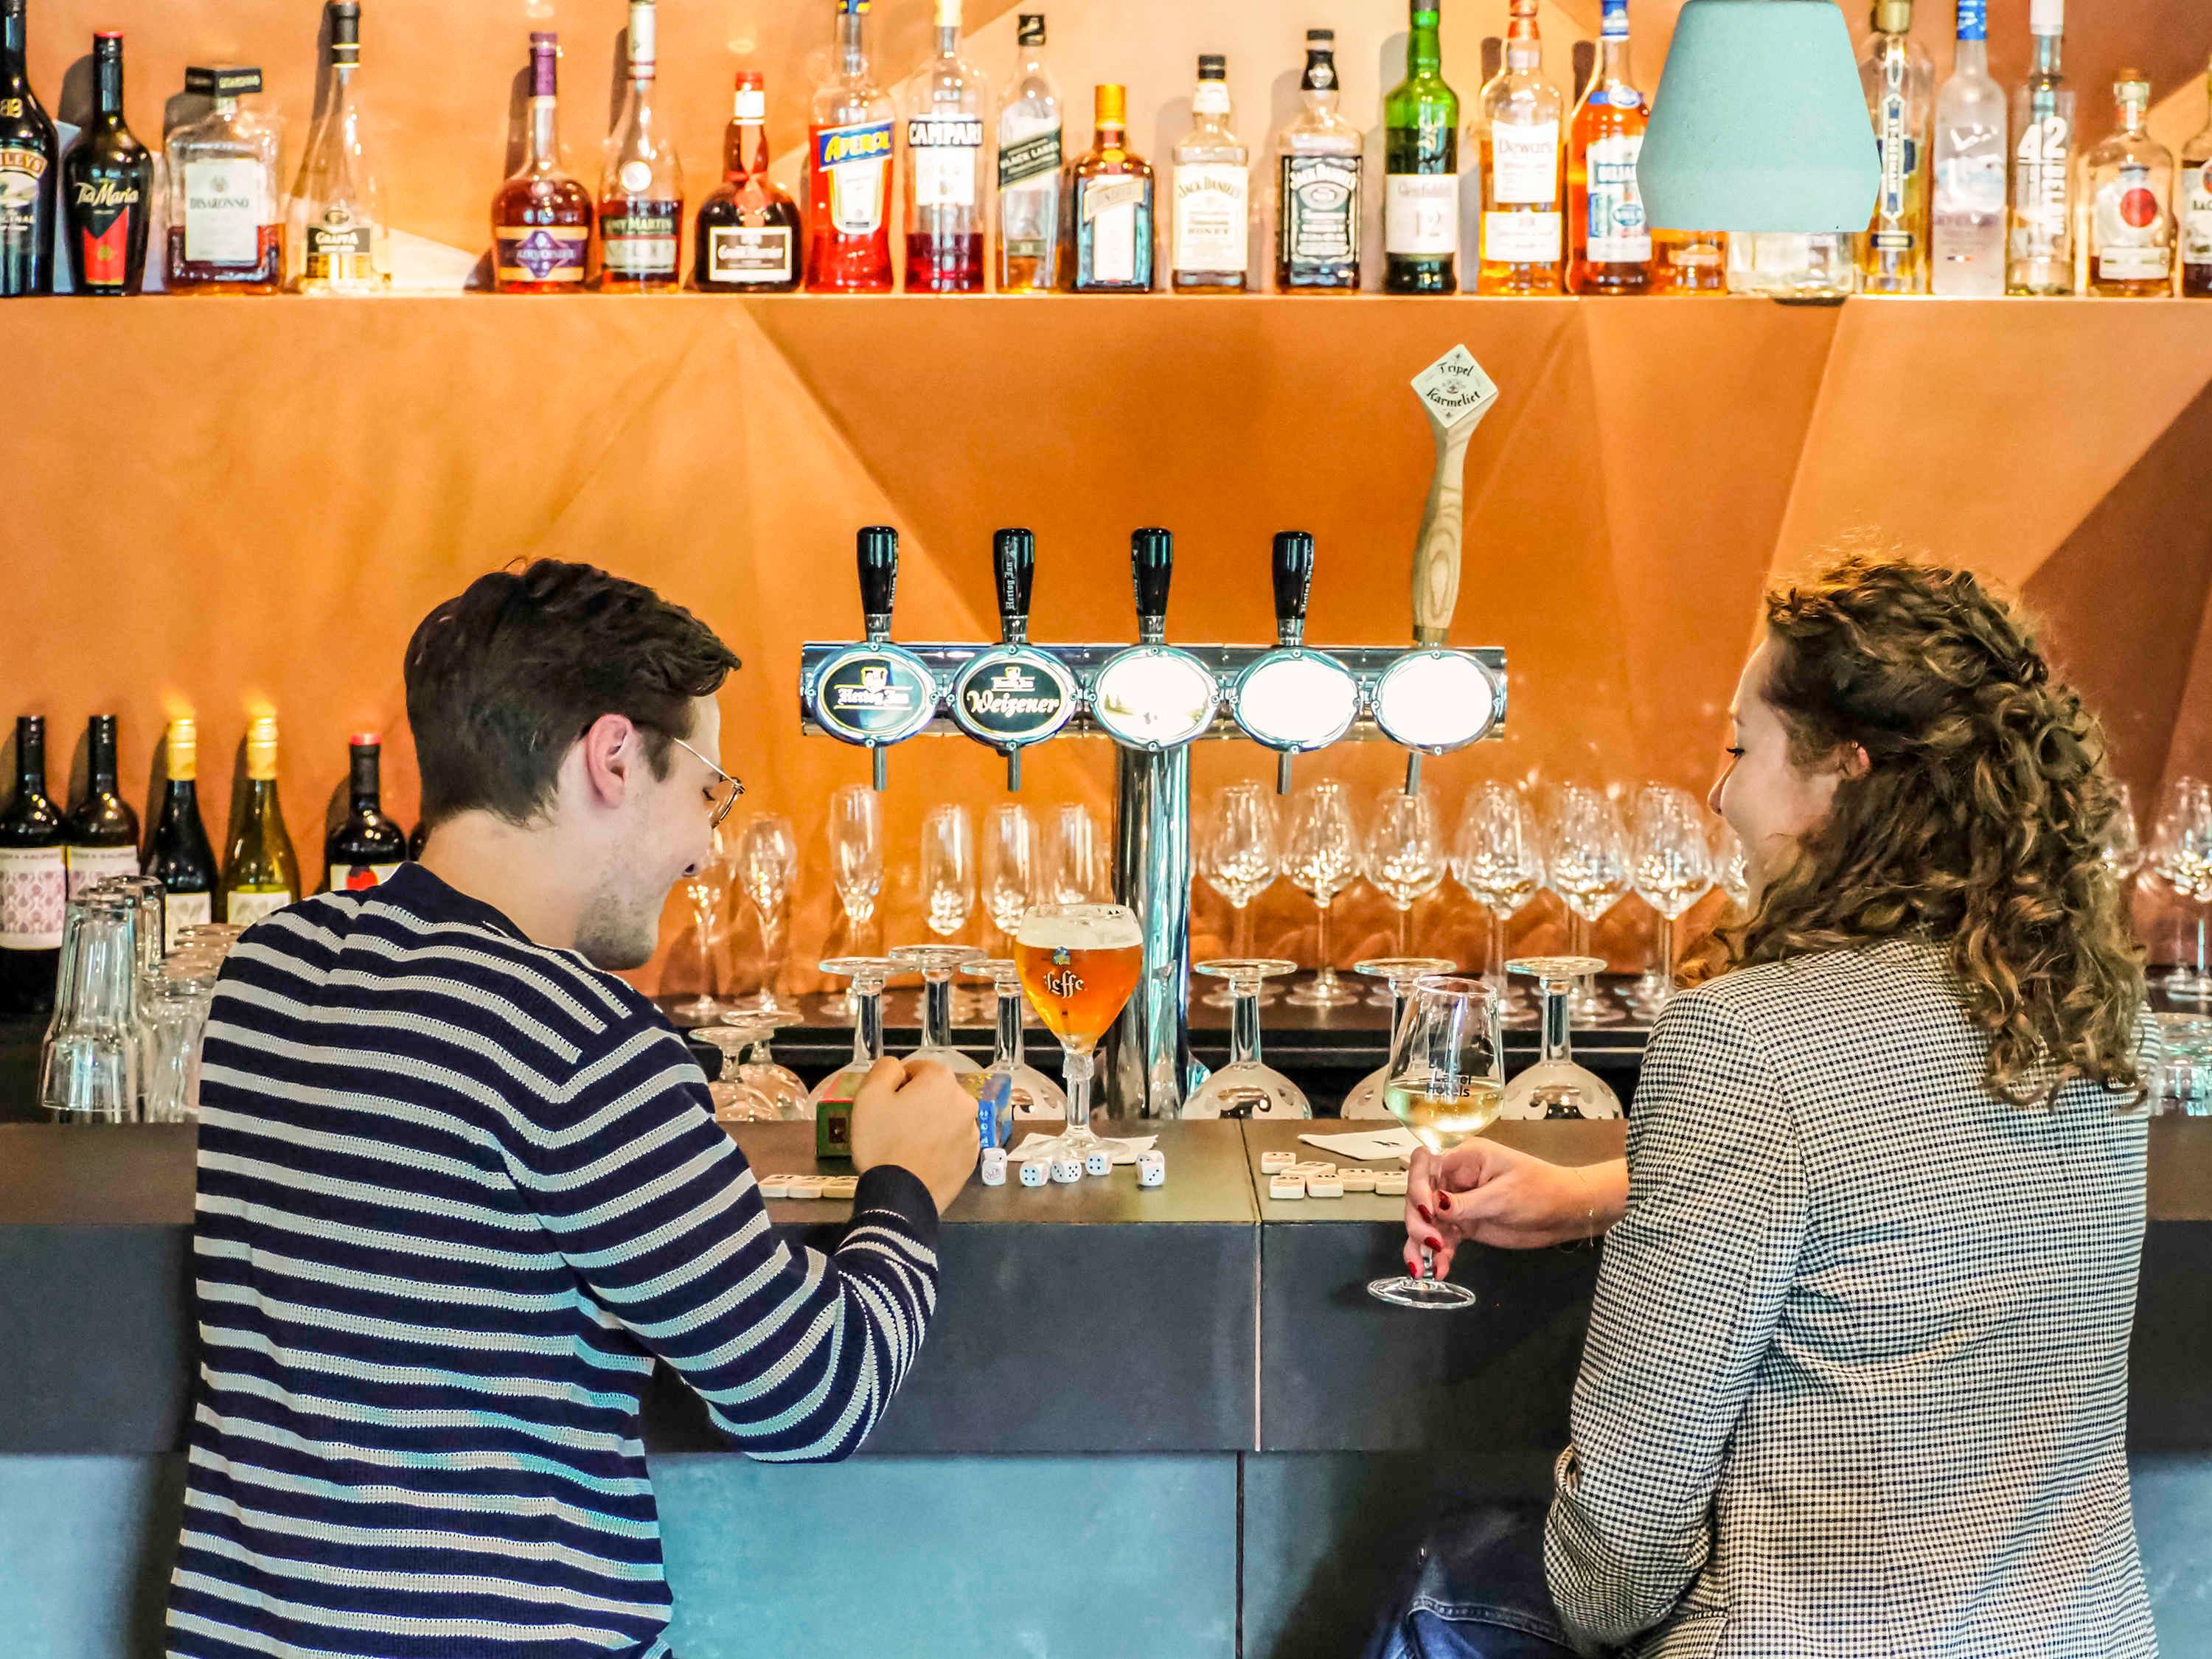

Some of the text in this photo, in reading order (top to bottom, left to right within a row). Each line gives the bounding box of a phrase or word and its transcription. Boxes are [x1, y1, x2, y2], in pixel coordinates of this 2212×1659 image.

[824, 131, 891, 163] APEROL
[909, 122, 982, 145] CAMPARI
[2017, 116, 2067, 164] 42
[91, 183, 139, 207] Maria
[1437, 361, 1474, 376] Tripel
[1426, 387, 1481, 407] Karmeliet
[1004, 561, 1015, 611] Hertog Jan
[1043, 970, 1086, 1000] Leffe
